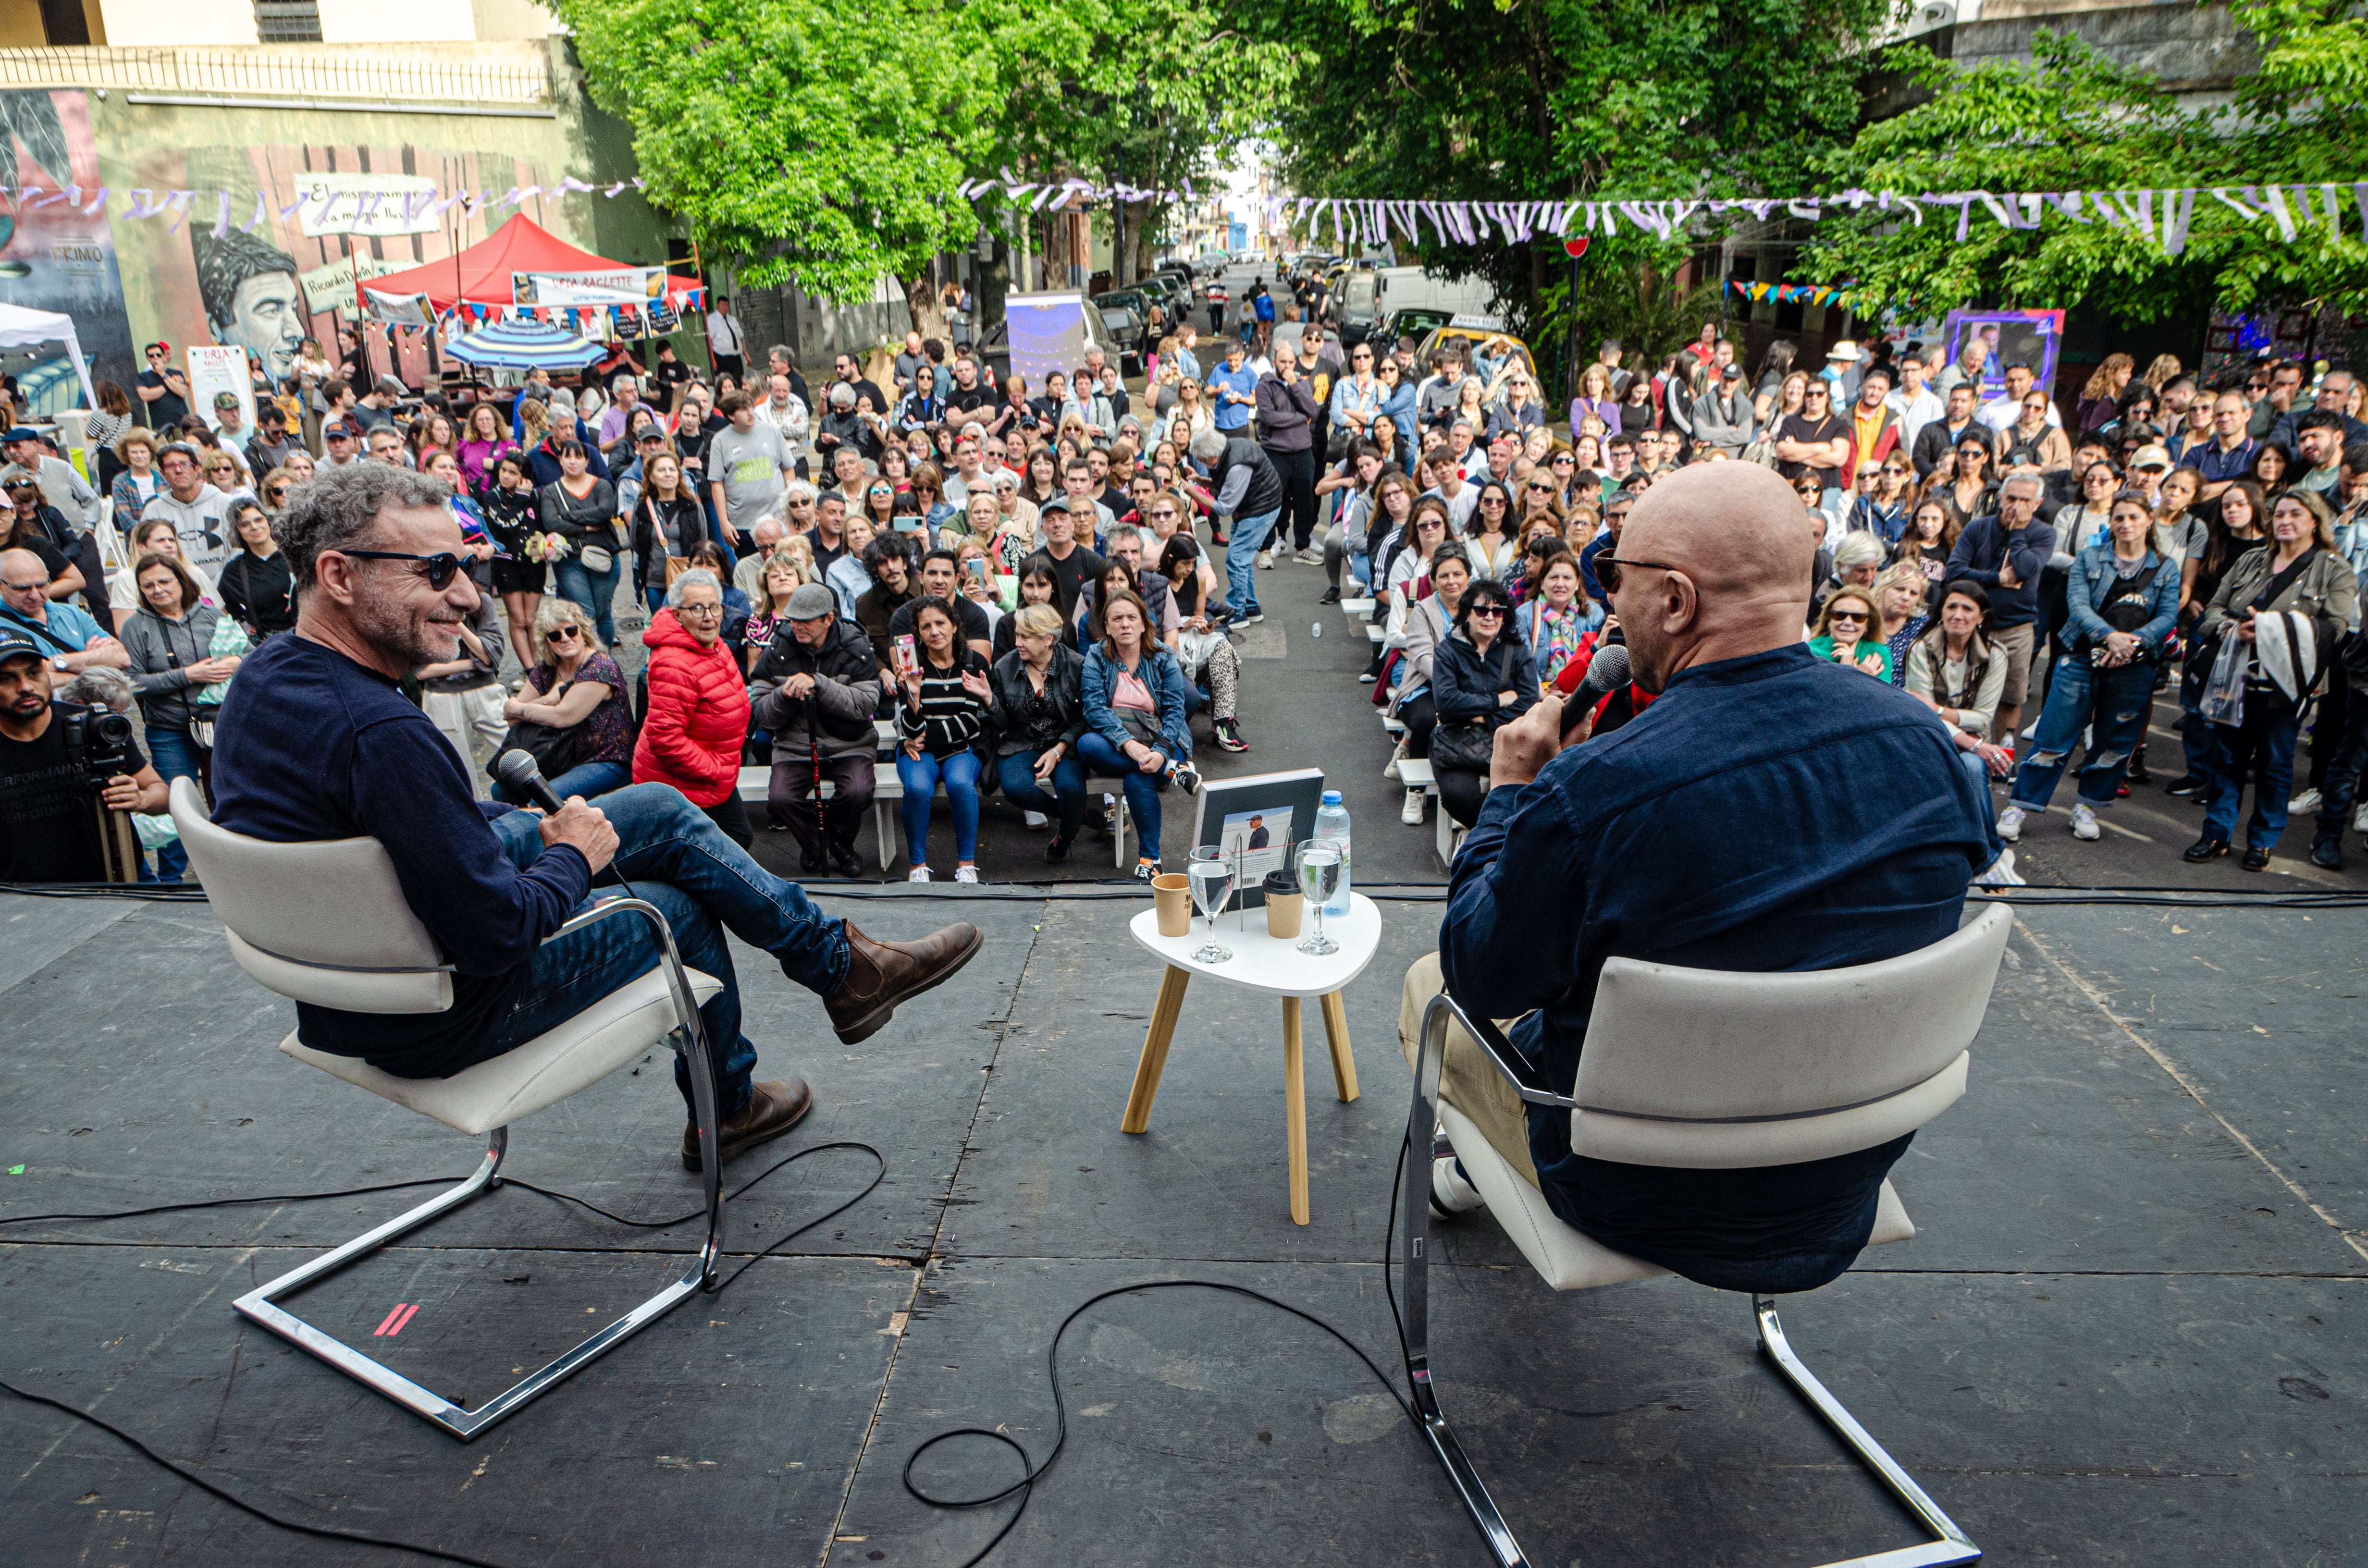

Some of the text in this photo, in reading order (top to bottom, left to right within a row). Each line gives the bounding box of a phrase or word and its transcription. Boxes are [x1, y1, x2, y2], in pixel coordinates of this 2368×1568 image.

[311, 183, 330, 202] El
[308, 273, 345, 295] Ricardo
[582, 275, 633, 288] RACLETTE
